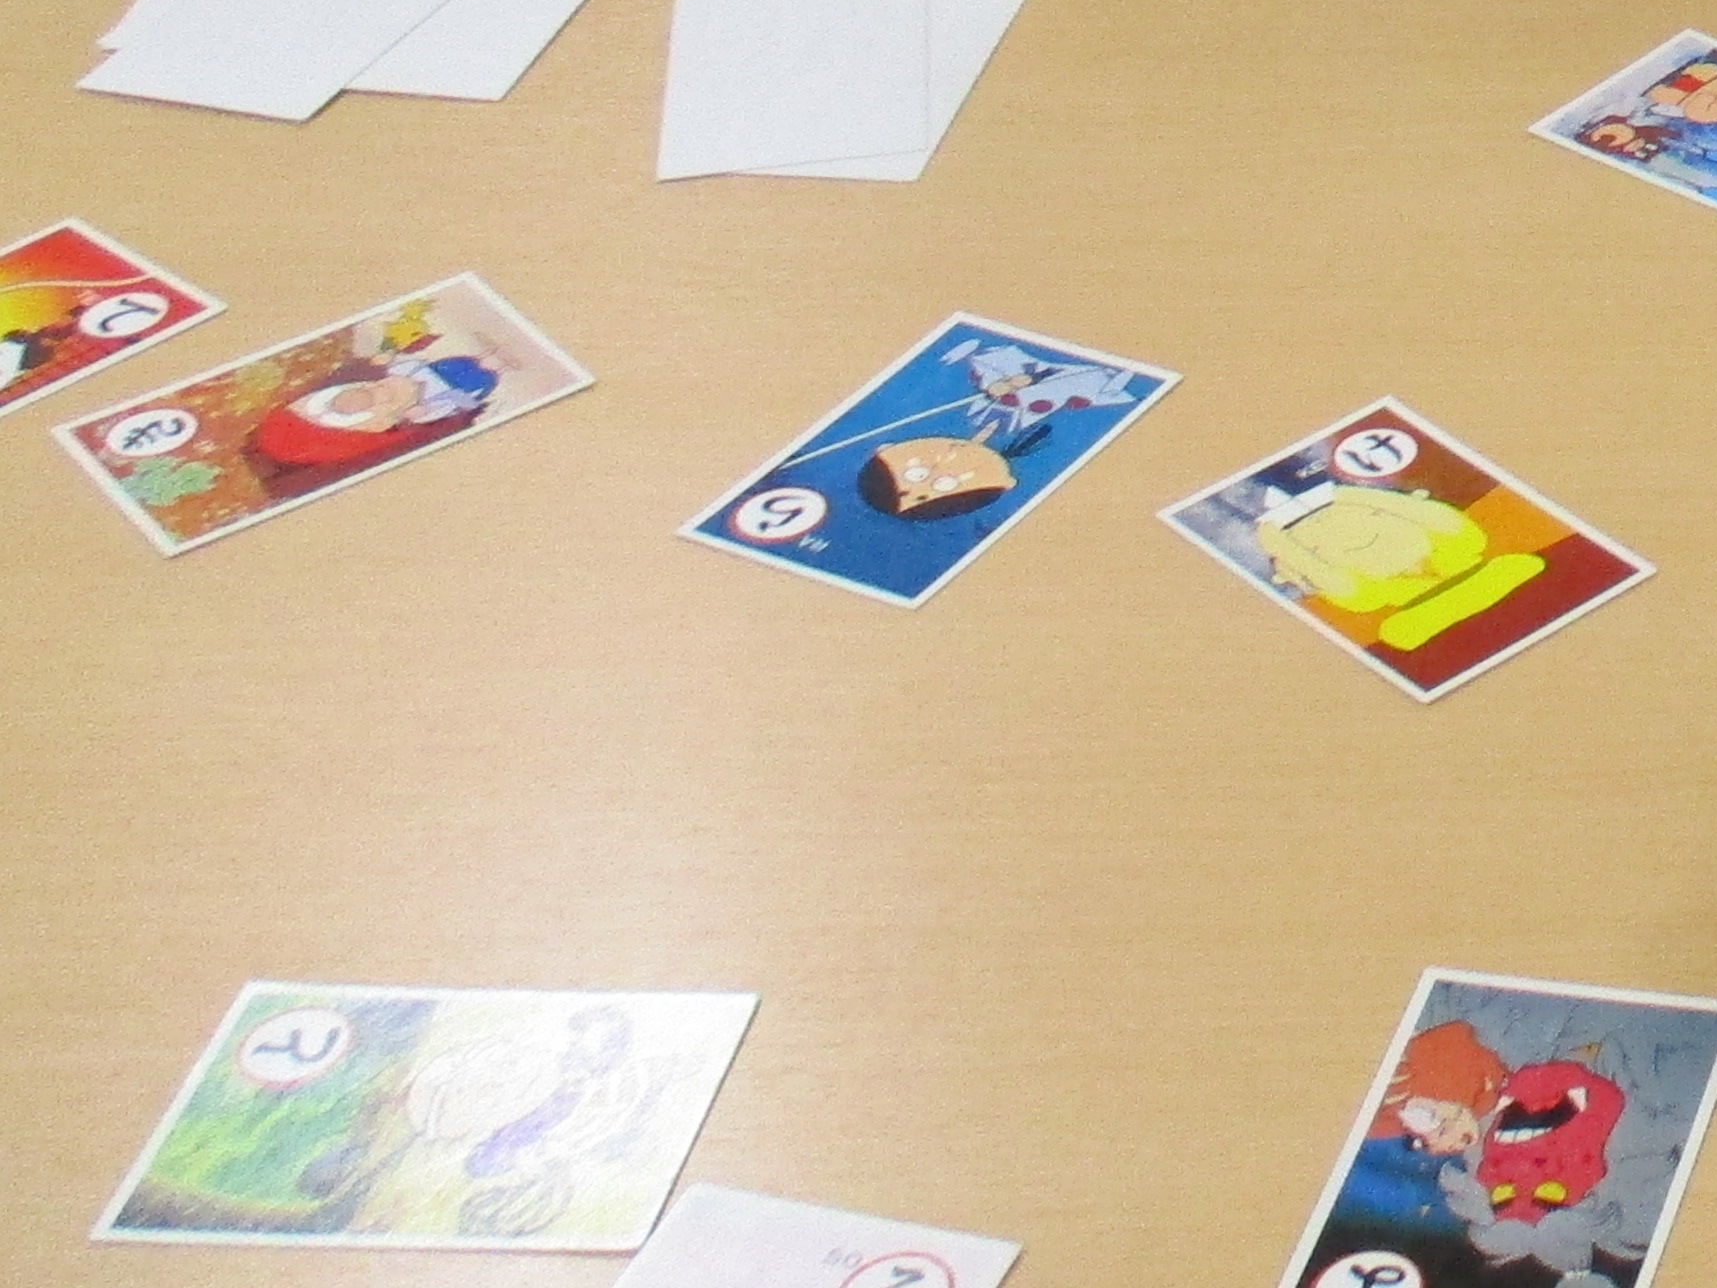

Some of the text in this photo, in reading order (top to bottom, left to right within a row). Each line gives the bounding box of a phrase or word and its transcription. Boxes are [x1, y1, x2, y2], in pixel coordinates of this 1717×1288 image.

[97, 298, 160, 334] て
[121, 417, 187, 451] き
[1342, 434, 1402, 473] け
[758, 494, 807, 532] ら
[250, 1026, 339, 1064] と
